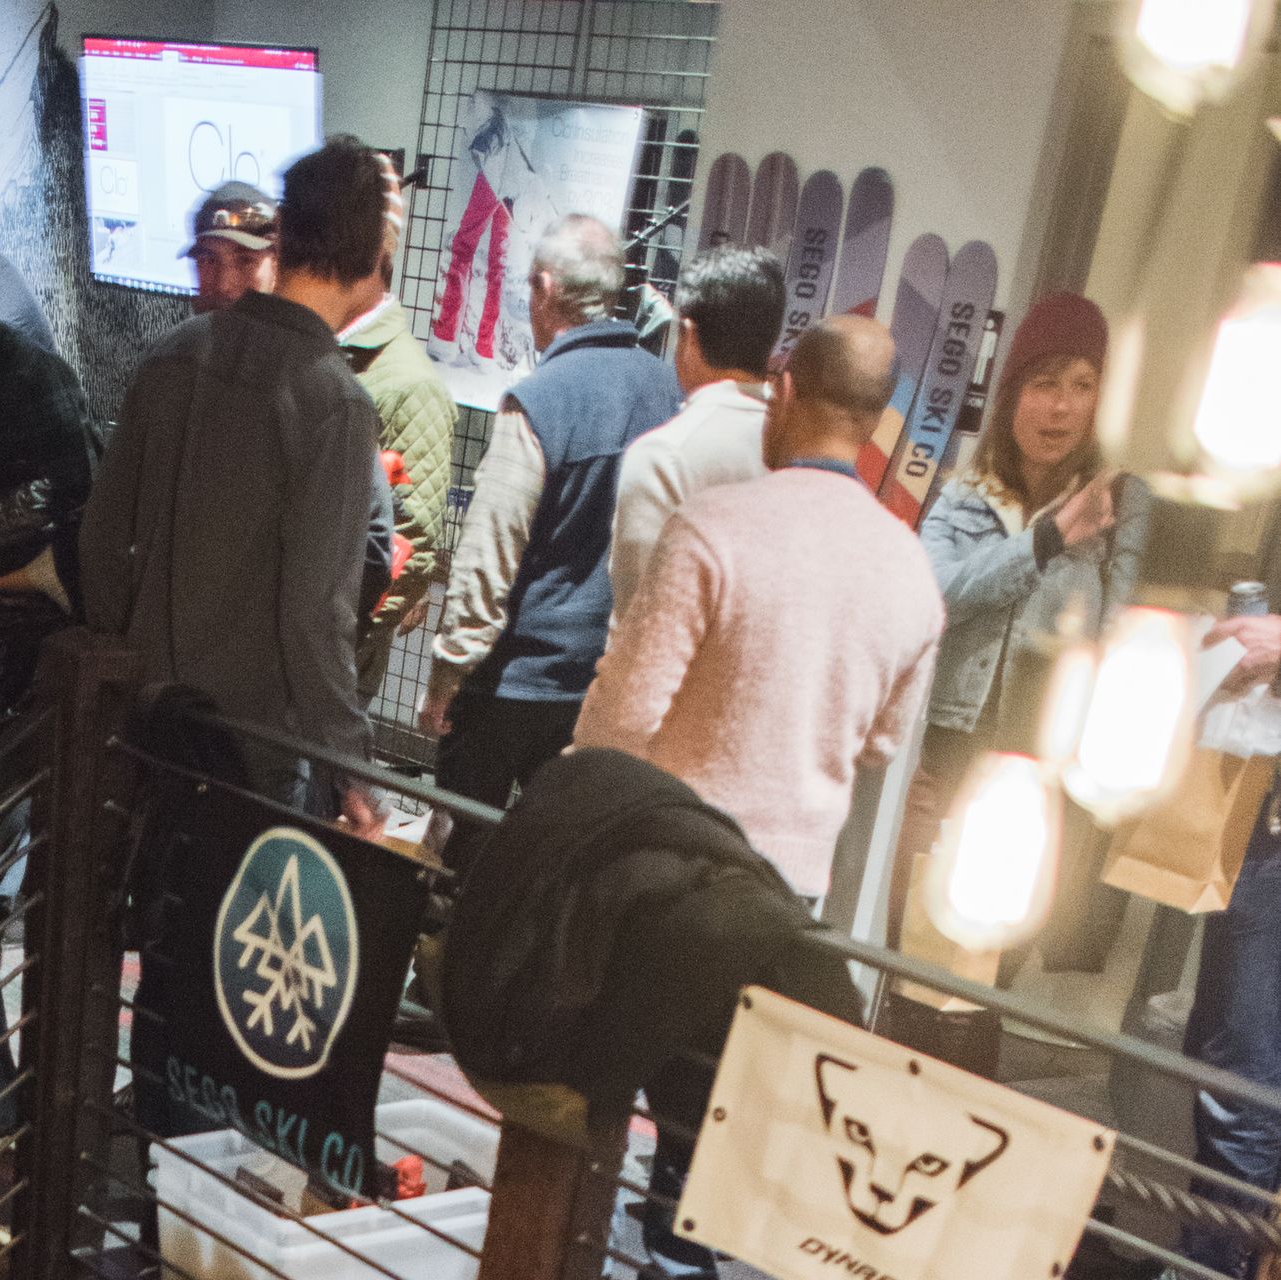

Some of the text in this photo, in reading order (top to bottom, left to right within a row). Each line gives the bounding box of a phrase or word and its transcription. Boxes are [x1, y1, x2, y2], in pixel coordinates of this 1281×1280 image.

[796, 228, 827, 300] SEGO
[905, 302, 975, 479] SEGO SKI CO
[254, 1099, 308, 1170] SKI
